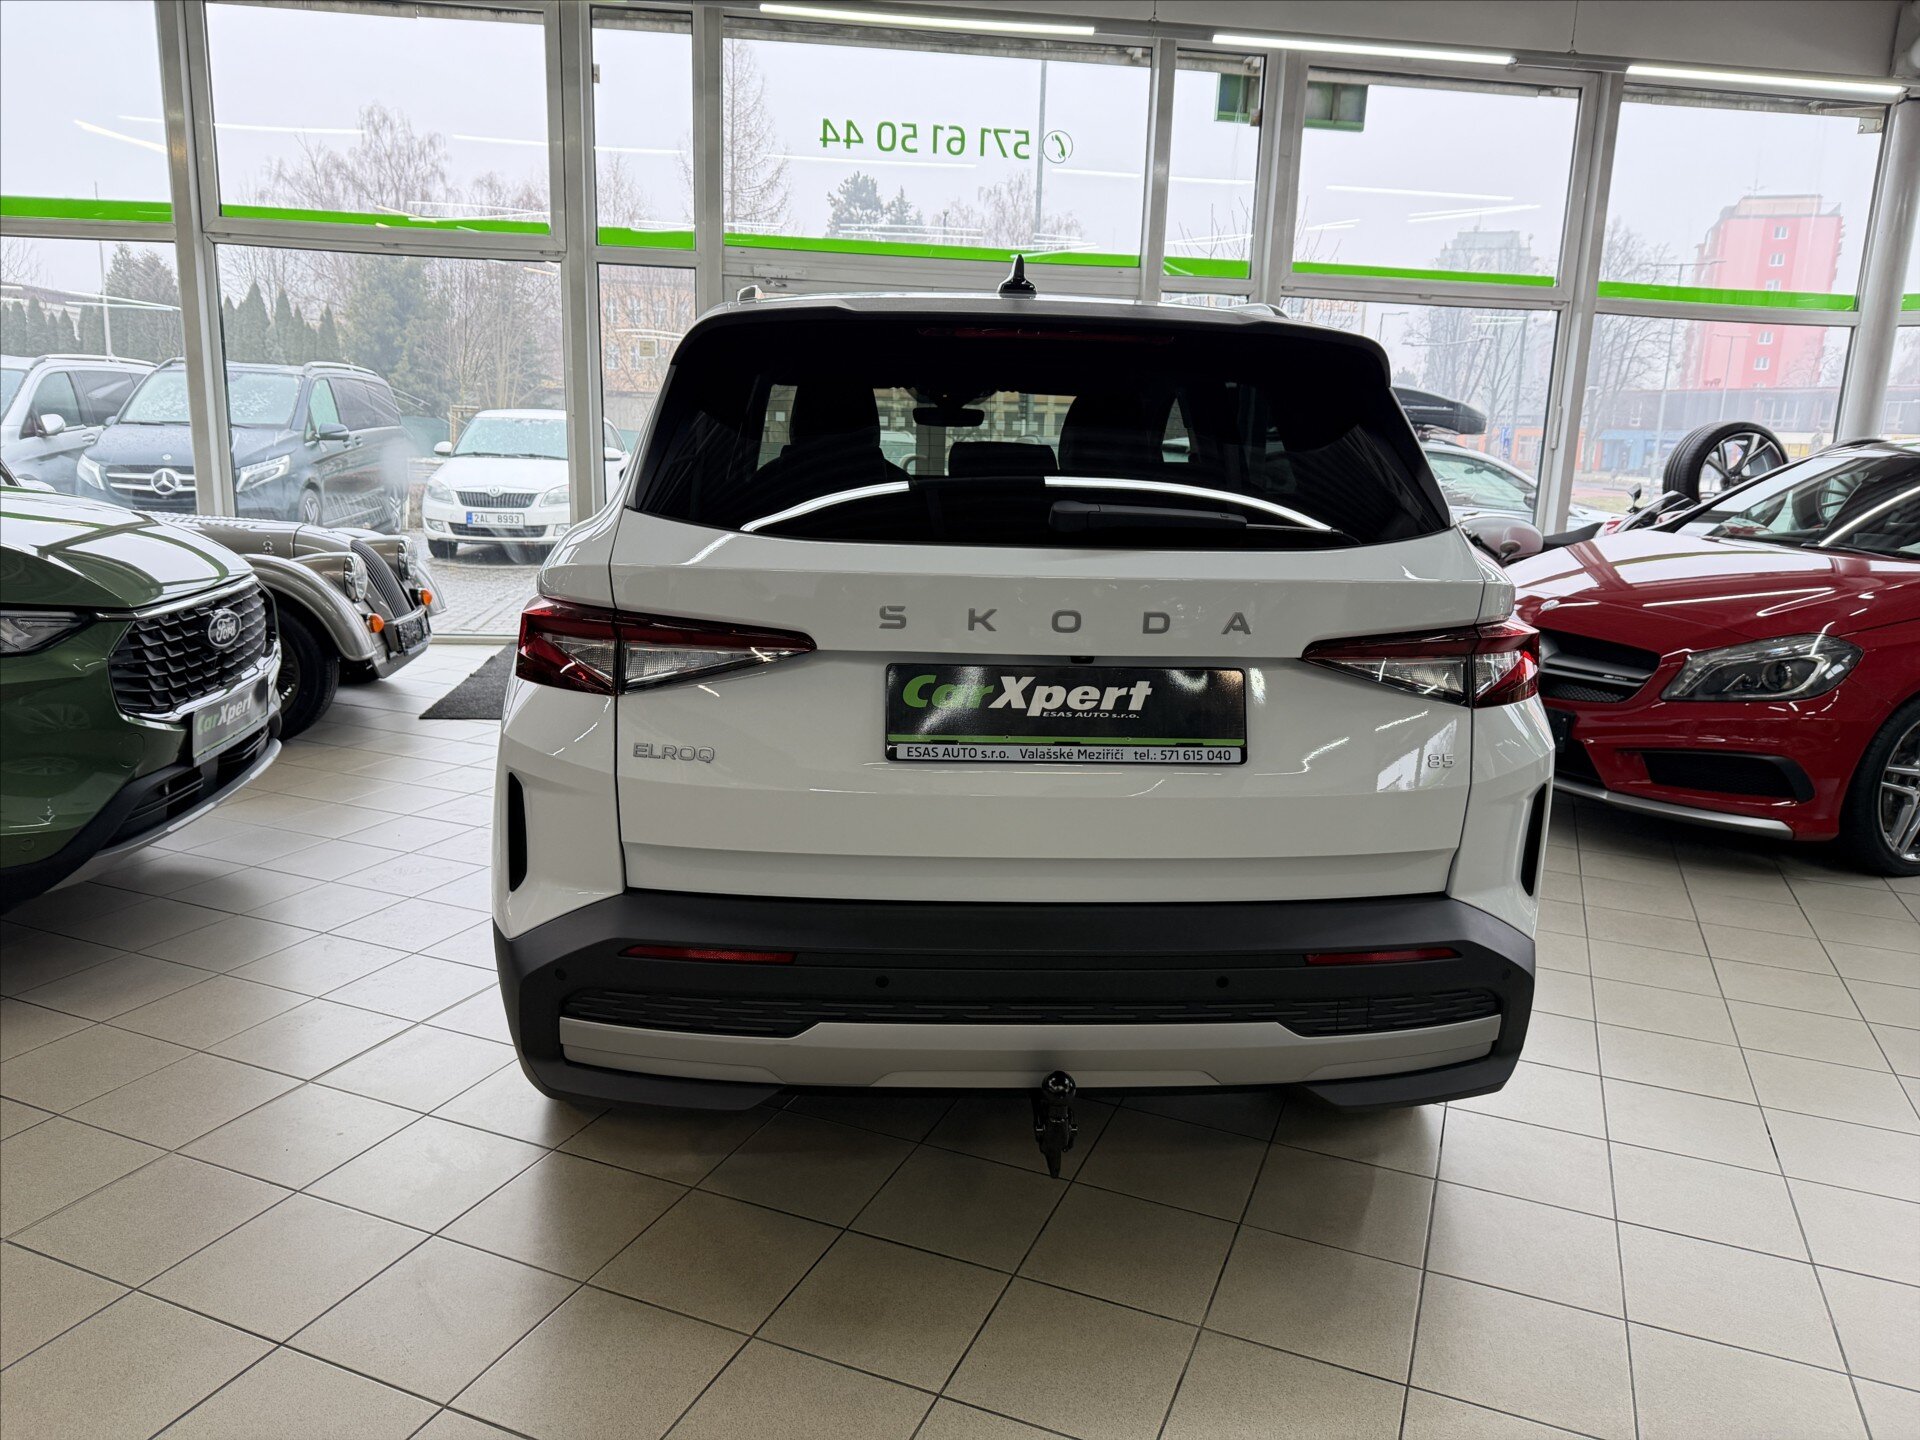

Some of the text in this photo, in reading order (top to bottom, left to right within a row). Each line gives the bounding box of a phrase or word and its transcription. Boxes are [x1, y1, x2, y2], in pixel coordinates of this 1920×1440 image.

[474, 514, 520, 524] 2AL 8993
[215, 617, 237, 641] Ford
[878, 605, 1252, 635] SKODA
[902, 674, 1153, 717] CarXpert
[197, 692, 252, 735] CarXpert
[632, 742, 715, 763] ELROQ
[906, 746, 1231, 761] ESAS AUTO s.r.o. Valašské Meziříčí tel.: 571 615 040
[1427, 753, 1455, 769] 85
